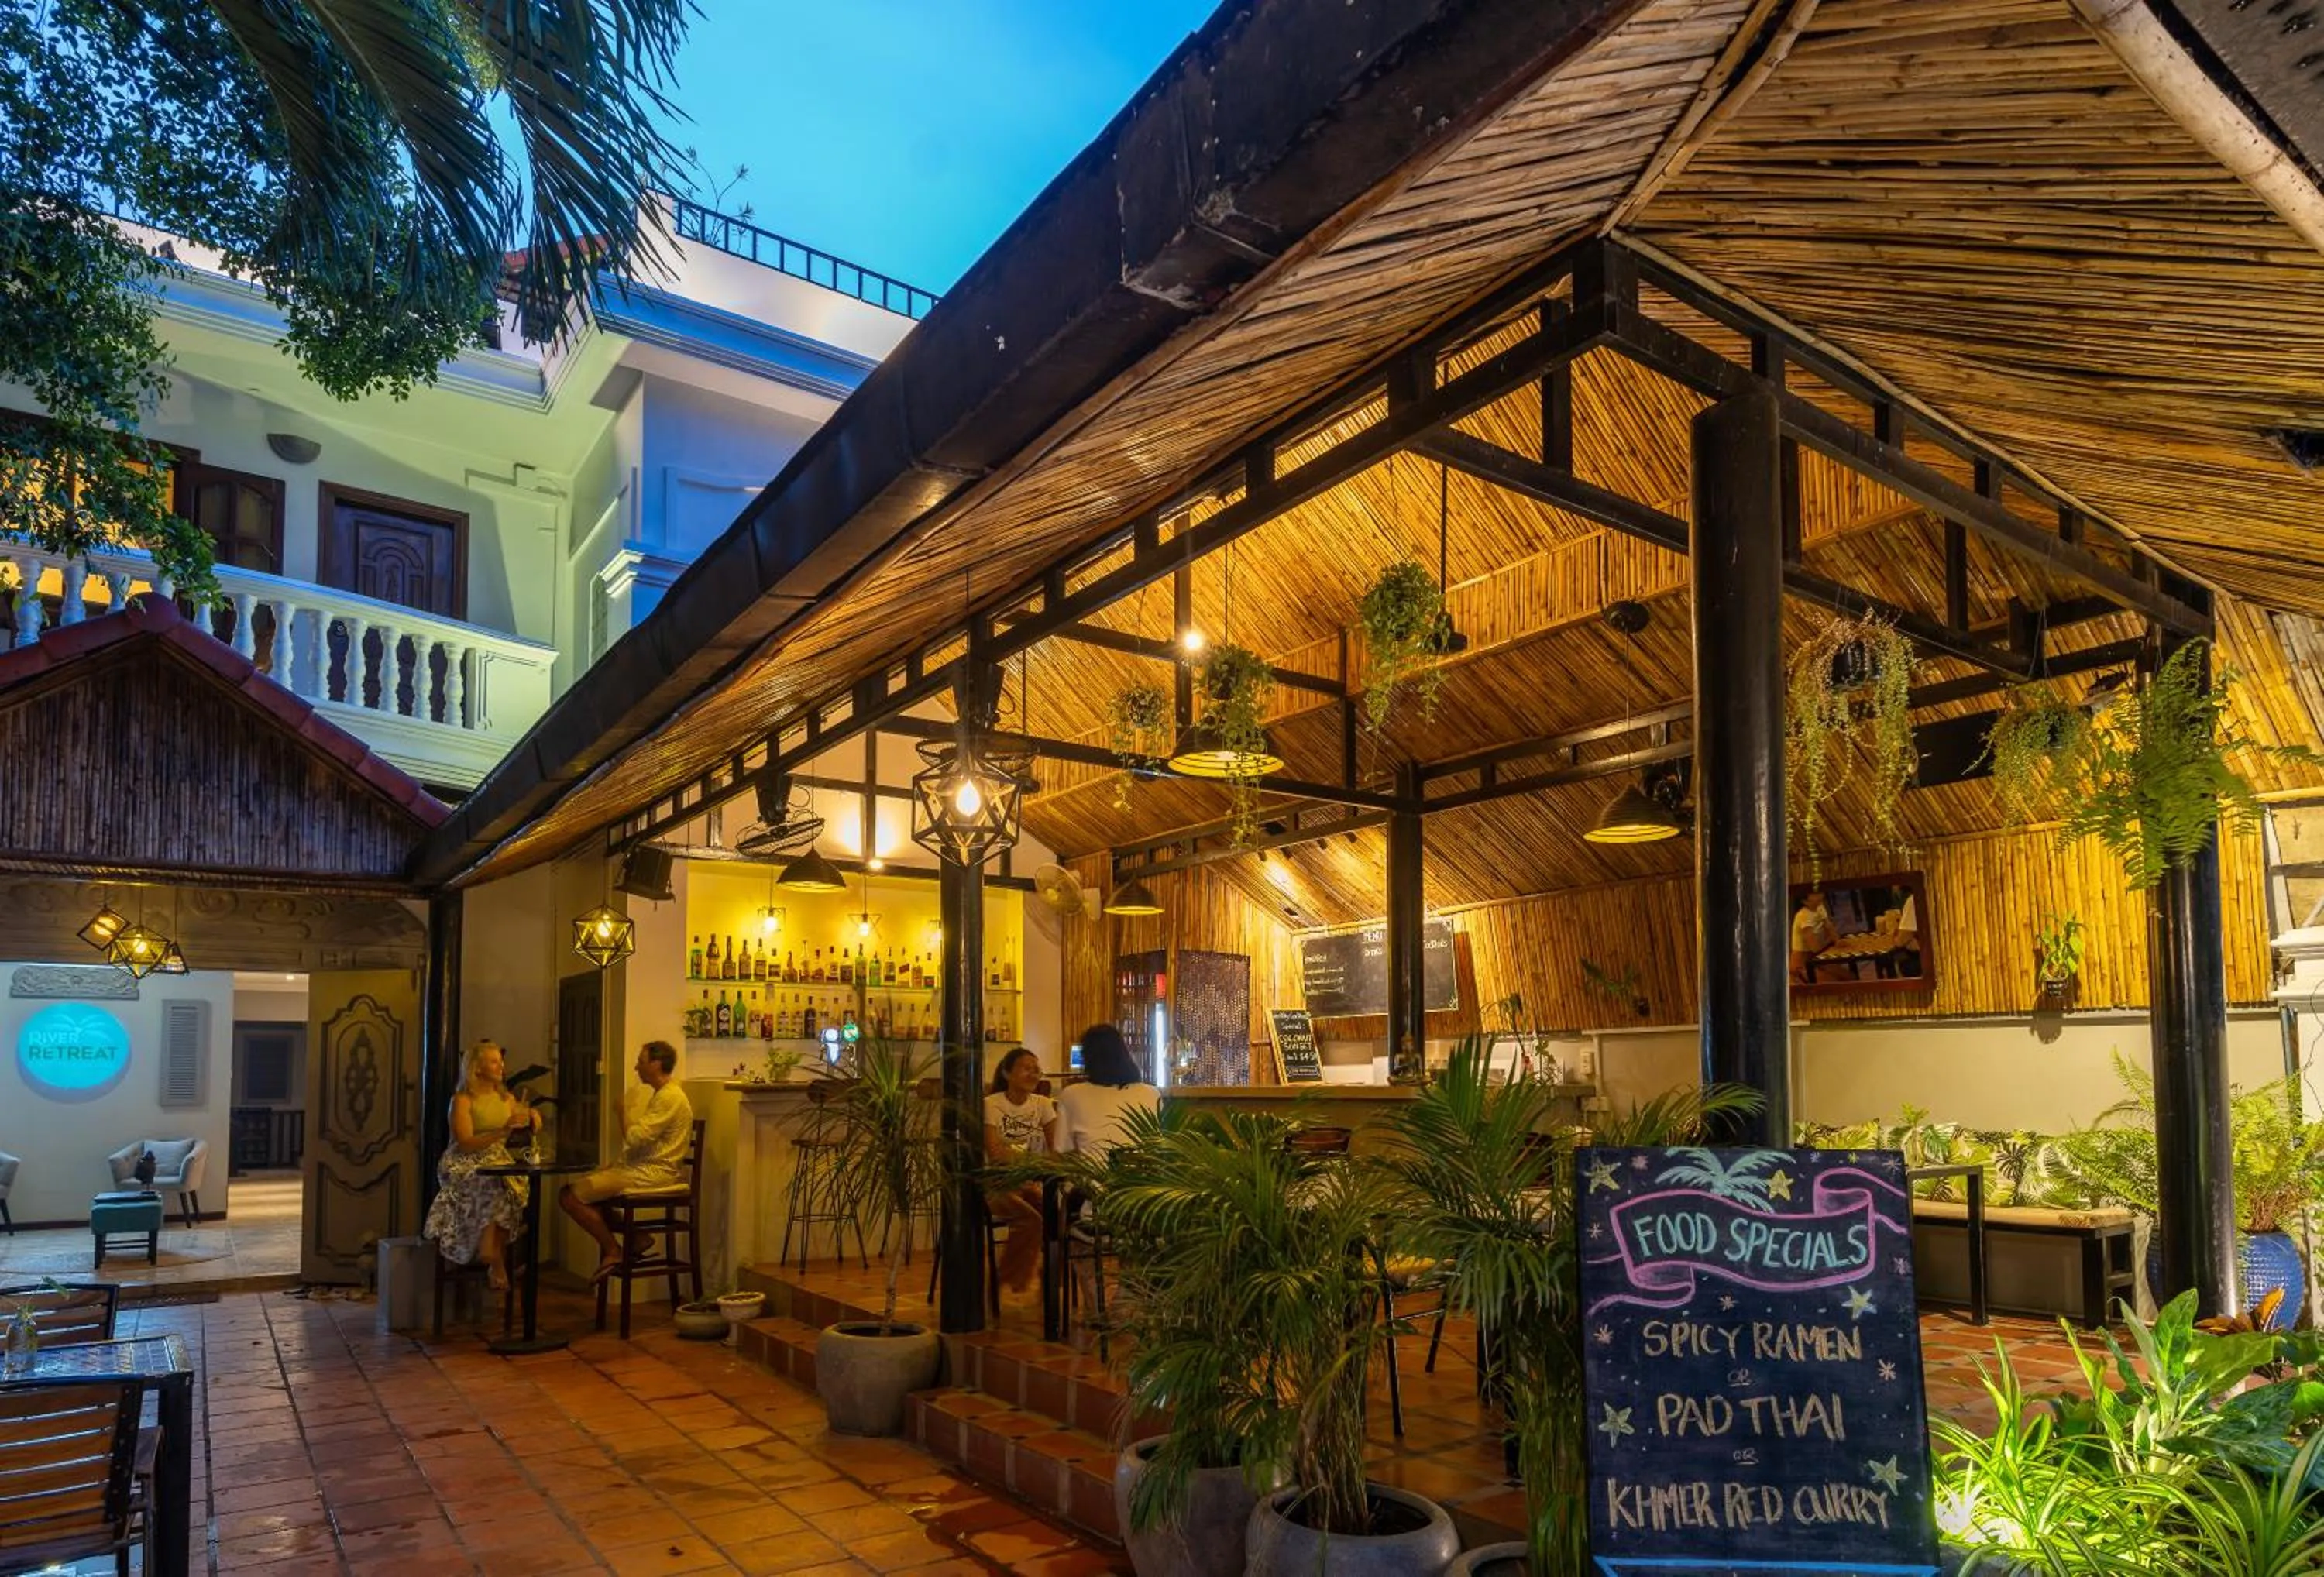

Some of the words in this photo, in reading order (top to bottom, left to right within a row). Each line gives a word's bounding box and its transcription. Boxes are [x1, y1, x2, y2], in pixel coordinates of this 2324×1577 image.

[29, 1031, 79, 1045] RIVER
[29, 1046, 117, 1060] RETREAT
[1633, 1212, 1717, 1257] FOOD
[1724, 1218, 1868, 1270] SPECIALS
[1642, 1321, 1742, 1359] SPICY
[1752, 1321, 1862, 1362] RAMEN
[1727, 1368, 1752, 1383] OR
[1657, 1393, 1734, 1437] PAD
[1740, 1393, 1846, 1441] THAI
[1733, 1447, 1759, 1462] OR
[1607, 1478, 1718, 1531] KHMER
[1724, 1481, 1782, 1530] RED
[1793, 1480, 1889, 1529] CURRY
